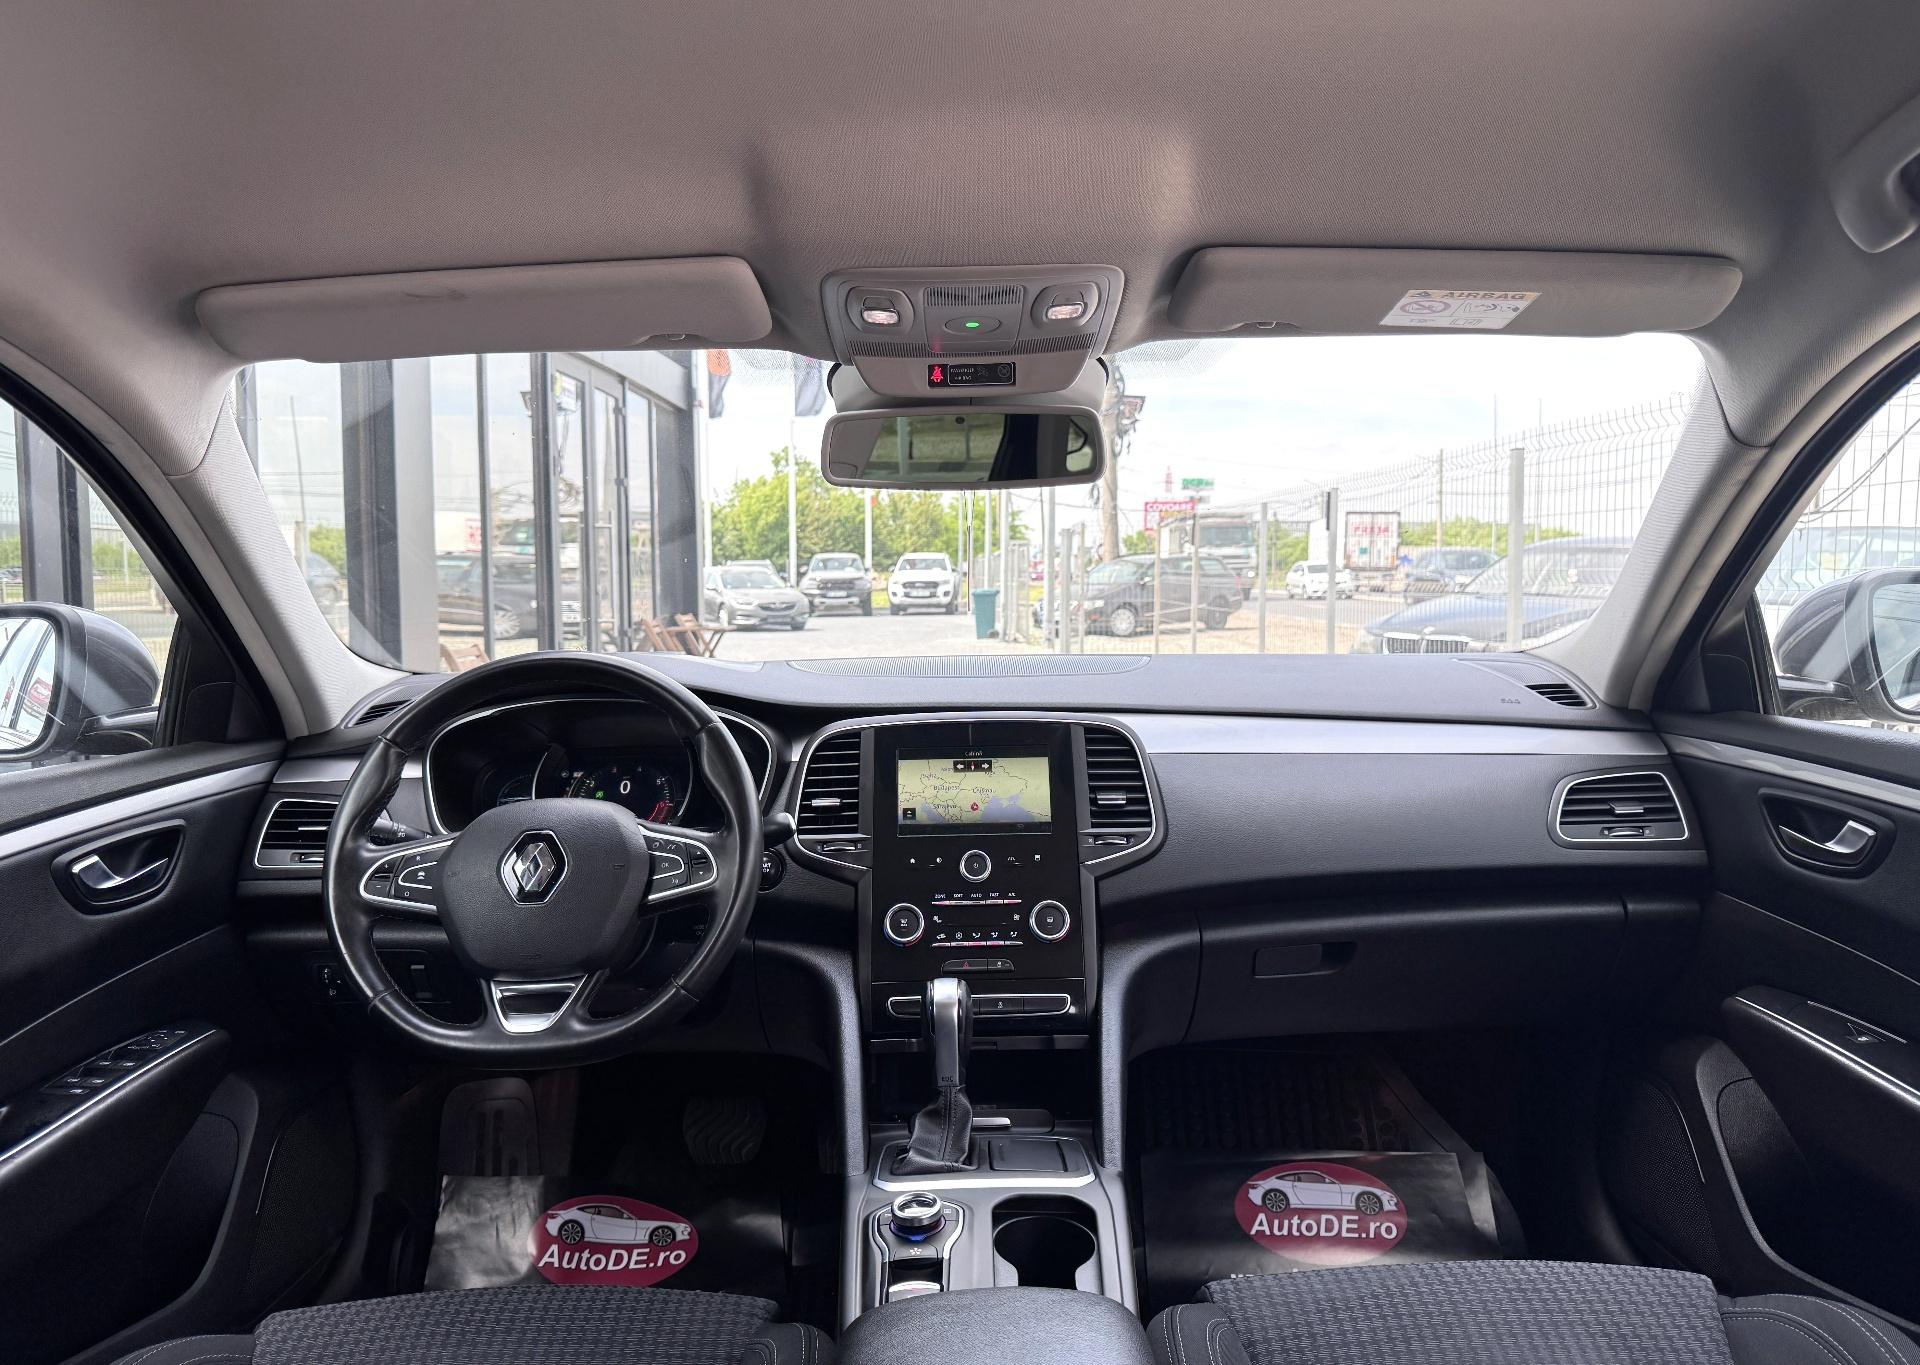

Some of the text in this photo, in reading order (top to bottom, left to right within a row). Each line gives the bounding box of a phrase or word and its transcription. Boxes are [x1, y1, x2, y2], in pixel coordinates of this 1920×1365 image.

[1440, 291, 1527, 300] AIRBAG
[1146, 503, 1193, 511] COVOARE
[620, 780, 631, 794] 0
[1250, 1212, 1398, 1241] AutoDE.ro
[537, 1243, 687, 1271] AutoDE.ro
